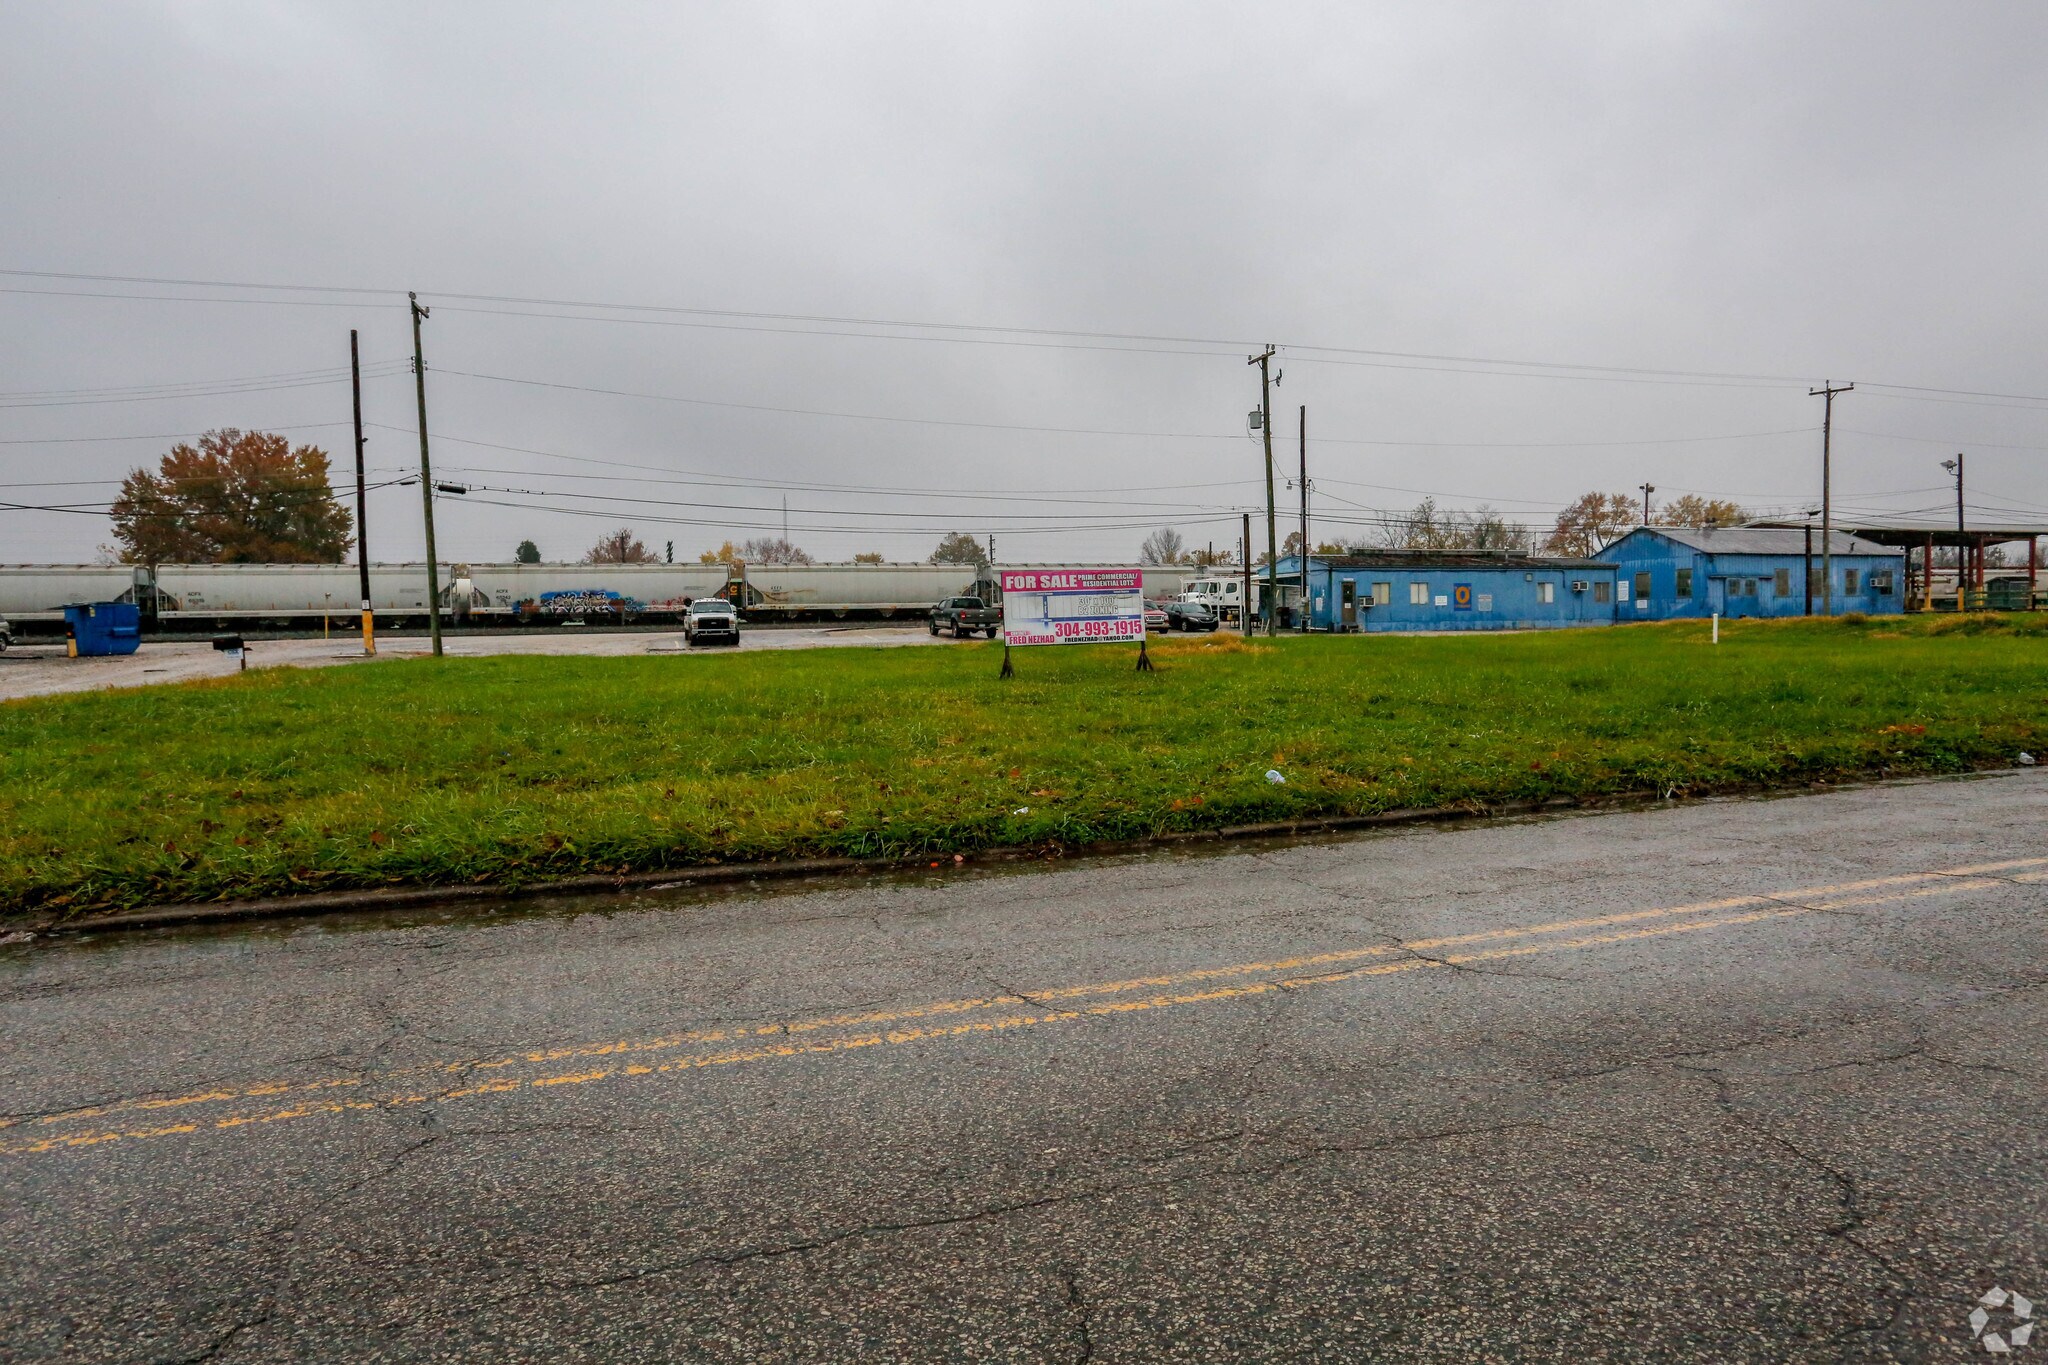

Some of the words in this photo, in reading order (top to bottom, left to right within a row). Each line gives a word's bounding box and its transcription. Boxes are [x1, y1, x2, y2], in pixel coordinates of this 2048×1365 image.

[1006, 575, 1036, 589] FOR
[1041, 574, 1077, 588] SALE
[1082, 579, 1119, 587] RESIDENTIAL
[1090, 605, 1118, 615] ZONING
[1055, 620, 1142, 637] 304-993-1915
[1009, 635, 1027, 645] FRED
[1028, 634, 1055, 644] NEZHAD
